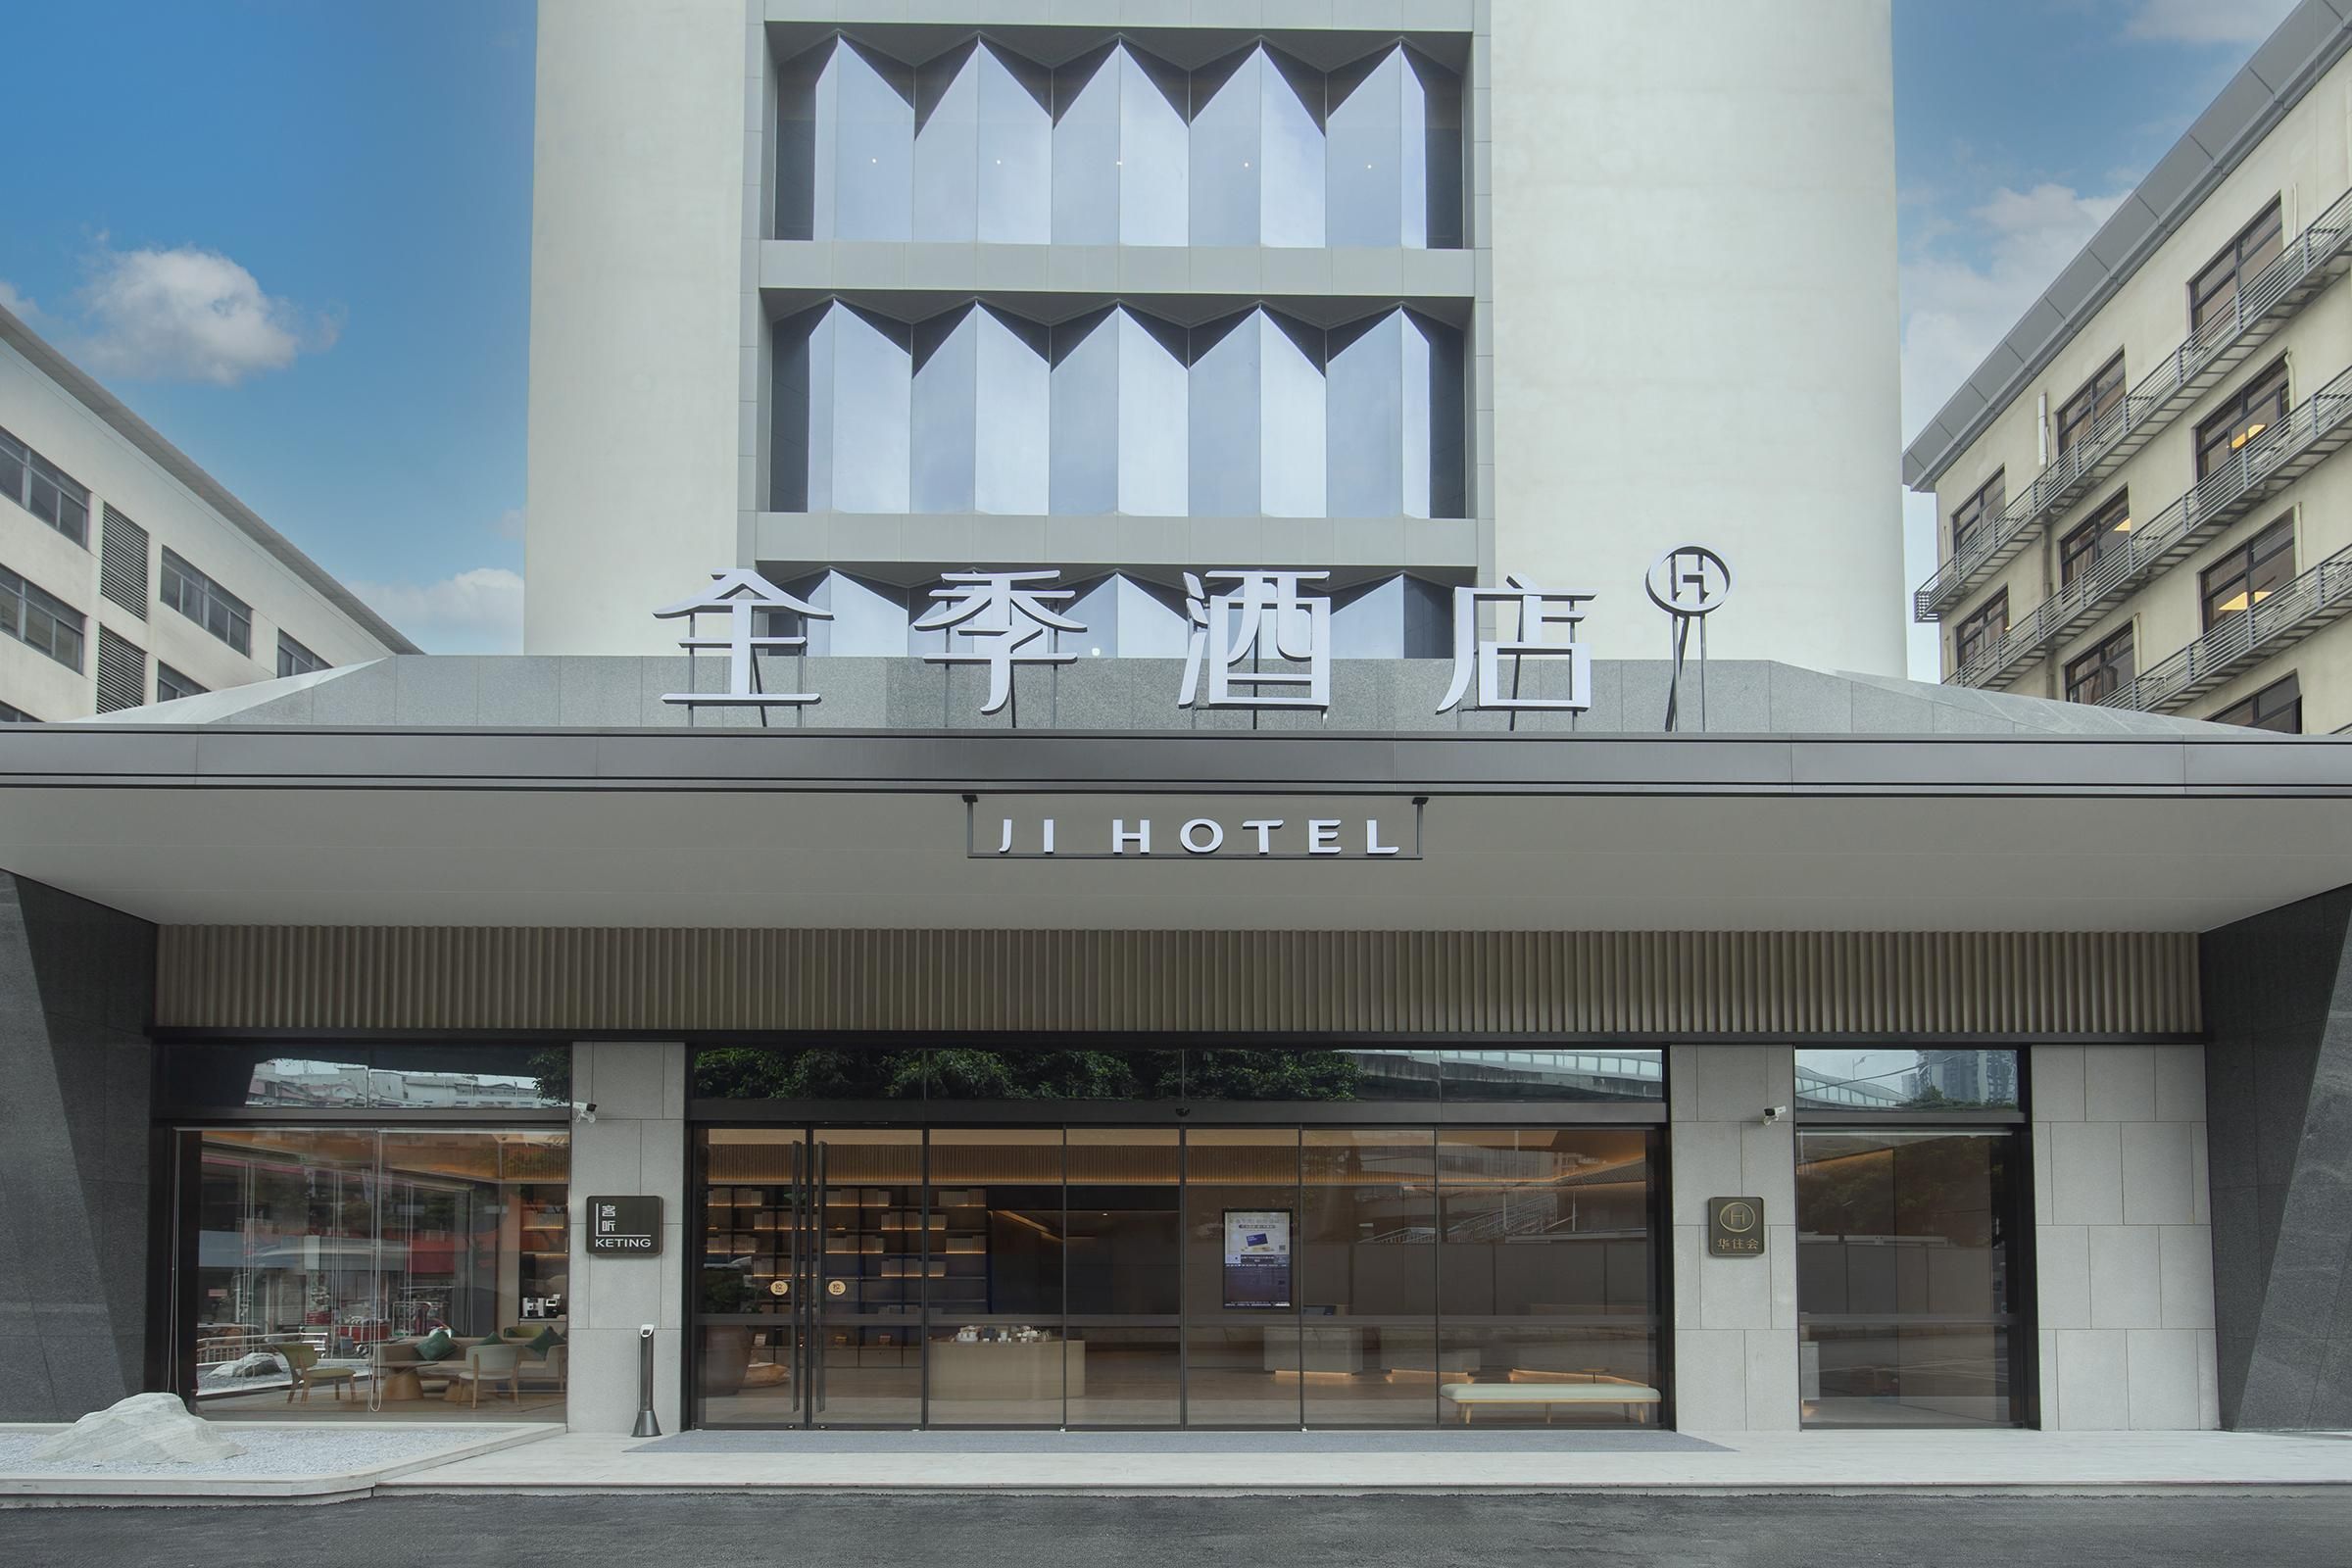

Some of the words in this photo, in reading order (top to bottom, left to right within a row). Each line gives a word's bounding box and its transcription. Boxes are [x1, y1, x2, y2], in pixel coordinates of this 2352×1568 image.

[654, 567, 1596, 714] 全季酒店
[998, 817, 1055, 854] JI
[1111, 817, 1401, 855] HOTEL
[595, 1238, 652, 1248] KETING
[1717, 1238, 1759, 1250] 华住会
